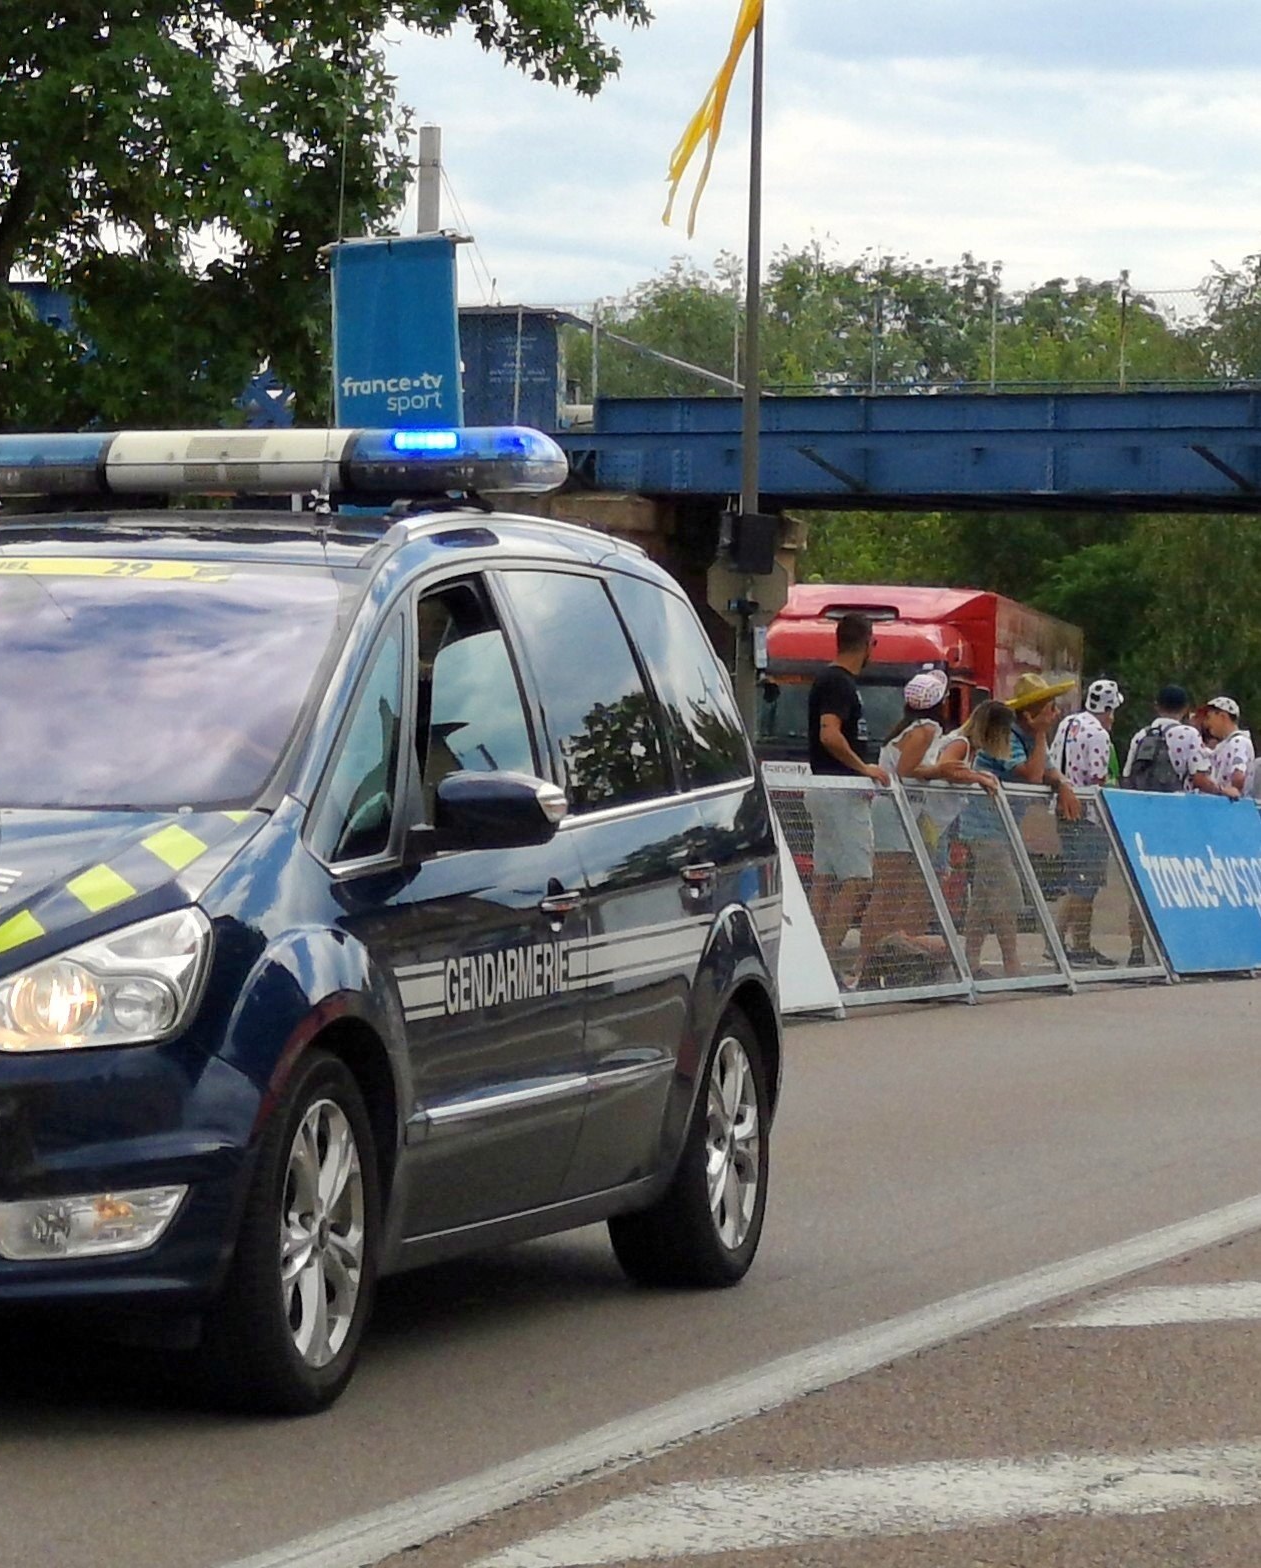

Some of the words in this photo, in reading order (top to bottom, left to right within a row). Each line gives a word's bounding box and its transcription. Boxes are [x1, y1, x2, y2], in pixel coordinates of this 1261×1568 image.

[386, 391, 443, 417] sport
[104, 561, 154, 576] 29
[445, 940, 569, 1016] GENDARMERIE
